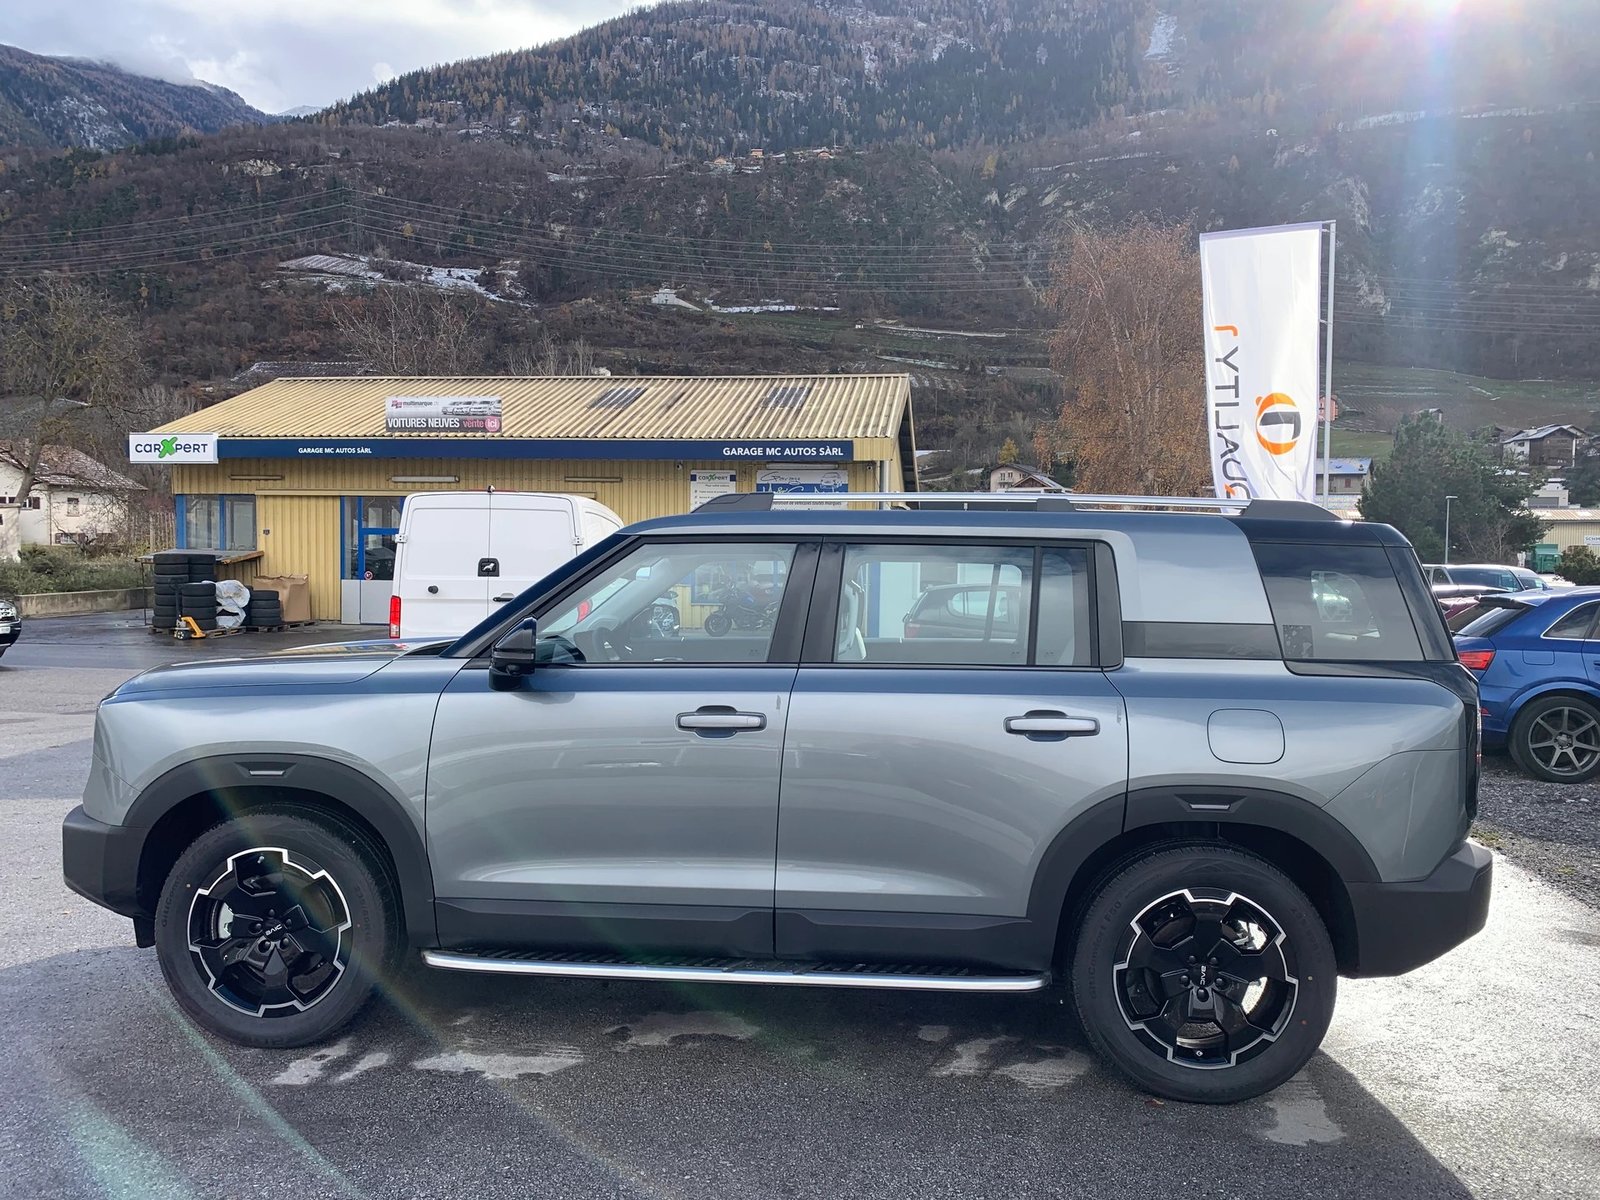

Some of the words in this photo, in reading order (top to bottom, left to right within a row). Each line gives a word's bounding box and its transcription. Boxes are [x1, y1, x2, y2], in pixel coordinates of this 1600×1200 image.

[387, 418, 427, 428] VOITURES
[428, 418, 460, 428] NEUVES
[462, 419, 485, 428] vente
[487, 418, 497, 428] ici
[722, 447, 764, 456] GARAGE
[766, 447, 781, 456] MC
[783, 447, 817, 456] AUTOS
